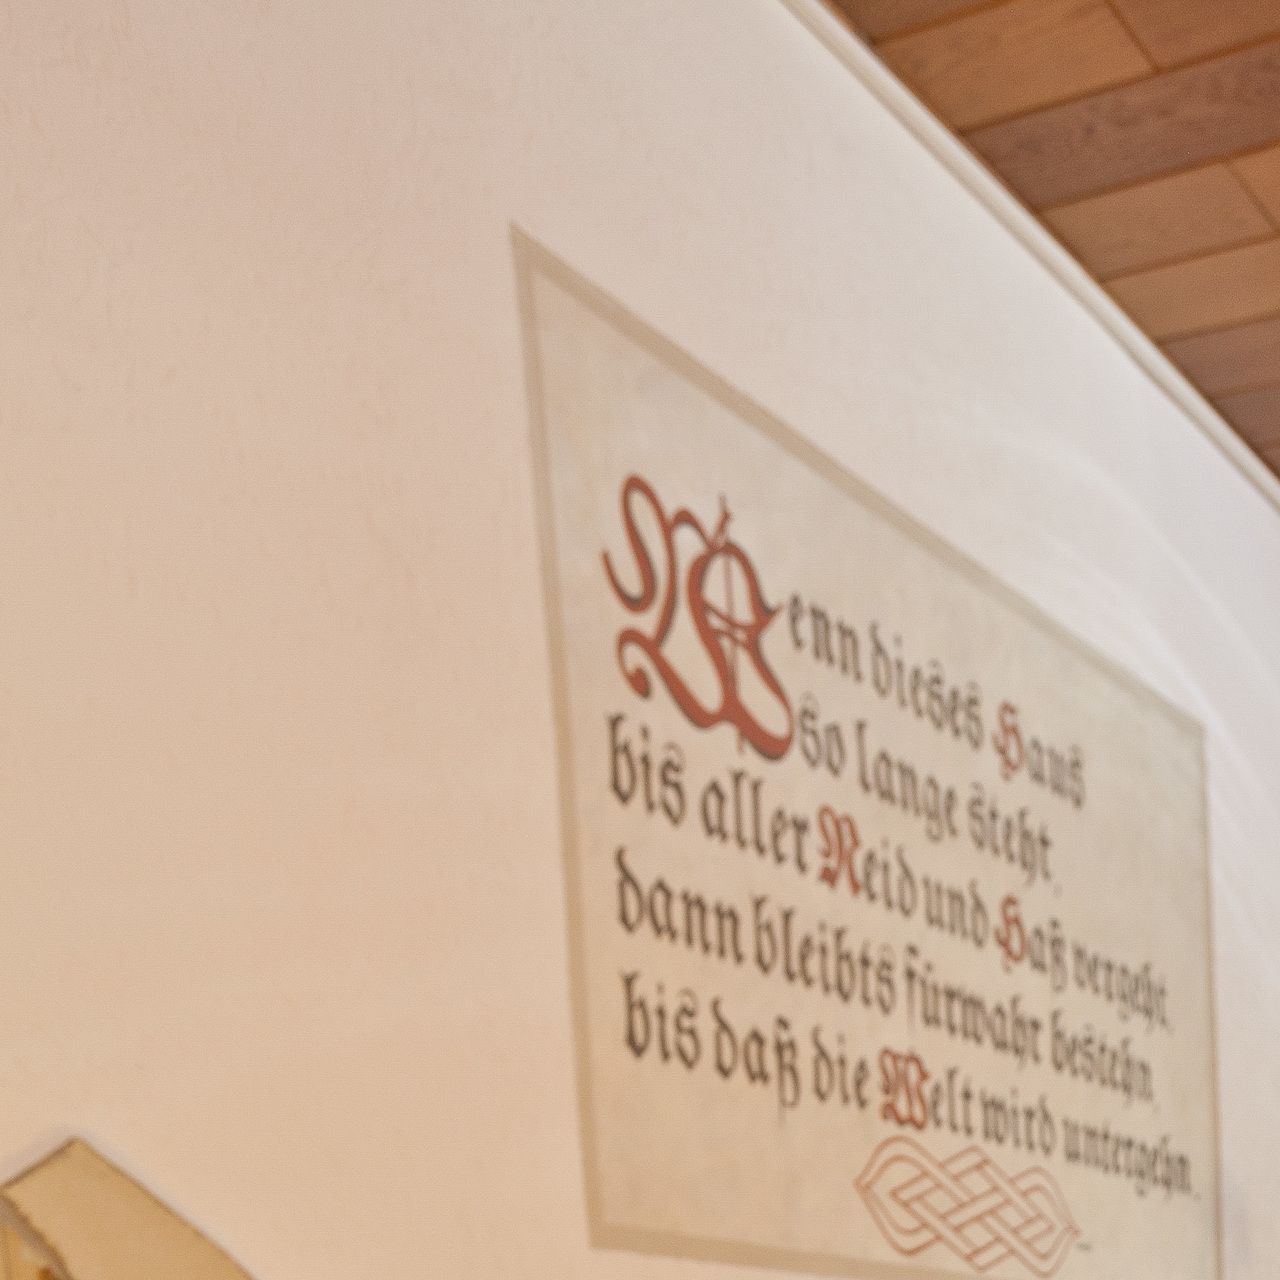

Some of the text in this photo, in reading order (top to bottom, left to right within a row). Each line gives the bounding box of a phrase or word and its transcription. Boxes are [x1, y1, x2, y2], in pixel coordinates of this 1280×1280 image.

[800, 692, 845, 777] so
[855, 719, 957, 843] lange
[868, 620, 984, 751] dieses
[992, 699, 1085, 811] Haus
[606, 713, 686, 827] bis
[701, 767, 810, 874] aller
[921, 877, 988, 948] und
[614, 846, 743, 967] dann
[752, 895, 898, 1016] bleibts
[620, 970, 699, 1069] bis
[709, 998, 800, 1127] daß
[810, 1024, 870, 1110] die
[879, 1049, 973, 1137] Welt
[979, 1090, 1056, 1157] wird
